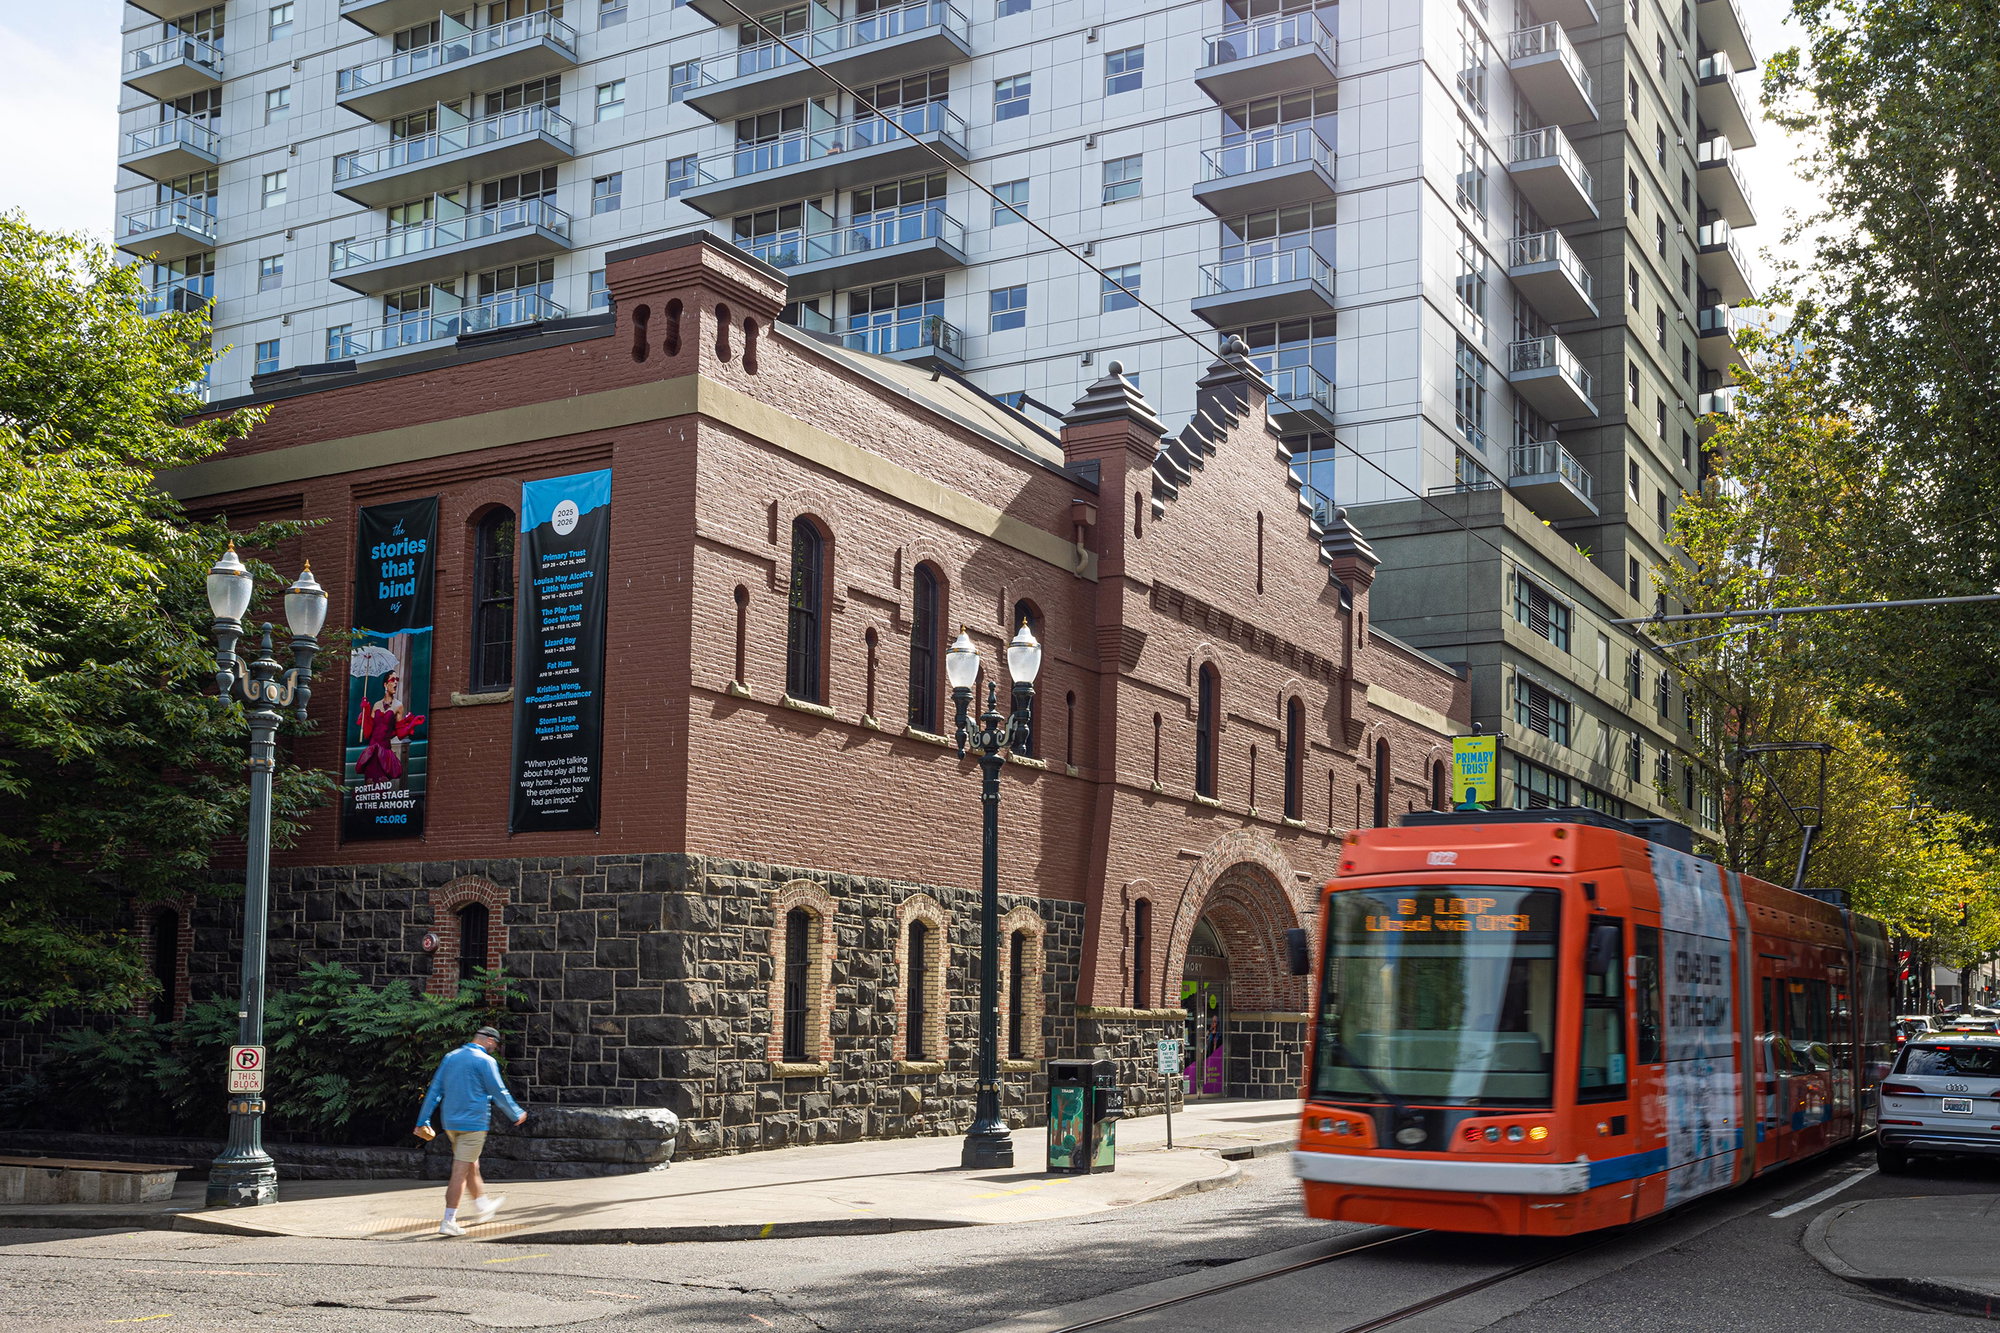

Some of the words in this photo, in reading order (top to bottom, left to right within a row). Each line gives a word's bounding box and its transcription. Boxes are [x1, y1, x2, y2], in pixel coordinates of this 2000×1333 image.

[557, 508, 574, 518] 2025
[392, 518, 405, 537] the
[557, 518, 573, 527] 2026
[371, 537, 427, 560] stories
[542, 553, 568, 562] Primary
[569, 549, 586, 558] Trust
[381, 558, 415, 578] that
[533, 577, 554, 586] Louisa
[554, 575, 568, 583] May
[569, 570, 594, 580] Alcott's
[379, 577, 415, 600] bind
[542, 585, 559, 593] Little
[560, 582, 584, 591] Women
[569, 604, 583, 612] That
[543, 617, 559, 625] Goes
[559, 614, 580, 622] Wrong
[544, 638, 564, 647] Lizard
[564, 637, 577, 645] Boy
[547, 662, 557, 670] Fat
[558, 660, 572, 668] Ham
[536, 685, 560, 694] Kristina
[539, 717, 557, 726] Storm
[558, 715, 577, 724] Large
[535, 727, 554, 735] Makes
[561, 724, 580, 732] Home
[547, 757, 566, 768] you're
[566, 756, 588, 765] talking
[1455, 751, 1494, 764] PRIMARY
[523, 770, 543, 778] about
[554, 767, 567, 776] play
[568, 766, 576, 774] all
[576, 765, 588, 773] the
[1461, 763, 1489, 775] TRUST
[354, 781, 393, 794] PORTLAND
[520, 780, 535, 789] way
[535, 779, 553, 787] home
[559, 777, 572, 786] you
[572, 775, 591, 783] know
[355, 792, 381, 802] CENTER
[381, 789, 410, 800] STAGE
[526, 789, 538, 797] the
[538, 786, 572, 796] experience
[572, 785, 584, 793] has
[355, 802, 364, 810] AT
[364, 801, 378, 810] THE
[379, 799, 417, 809] ARMORY
[531, 797, 544, 806] had
[375, 813, 408, 824] PCS.ORG
[1185, 962, 1203, 972] MORY
[233, 1080, 259, 1088] BLOCK
